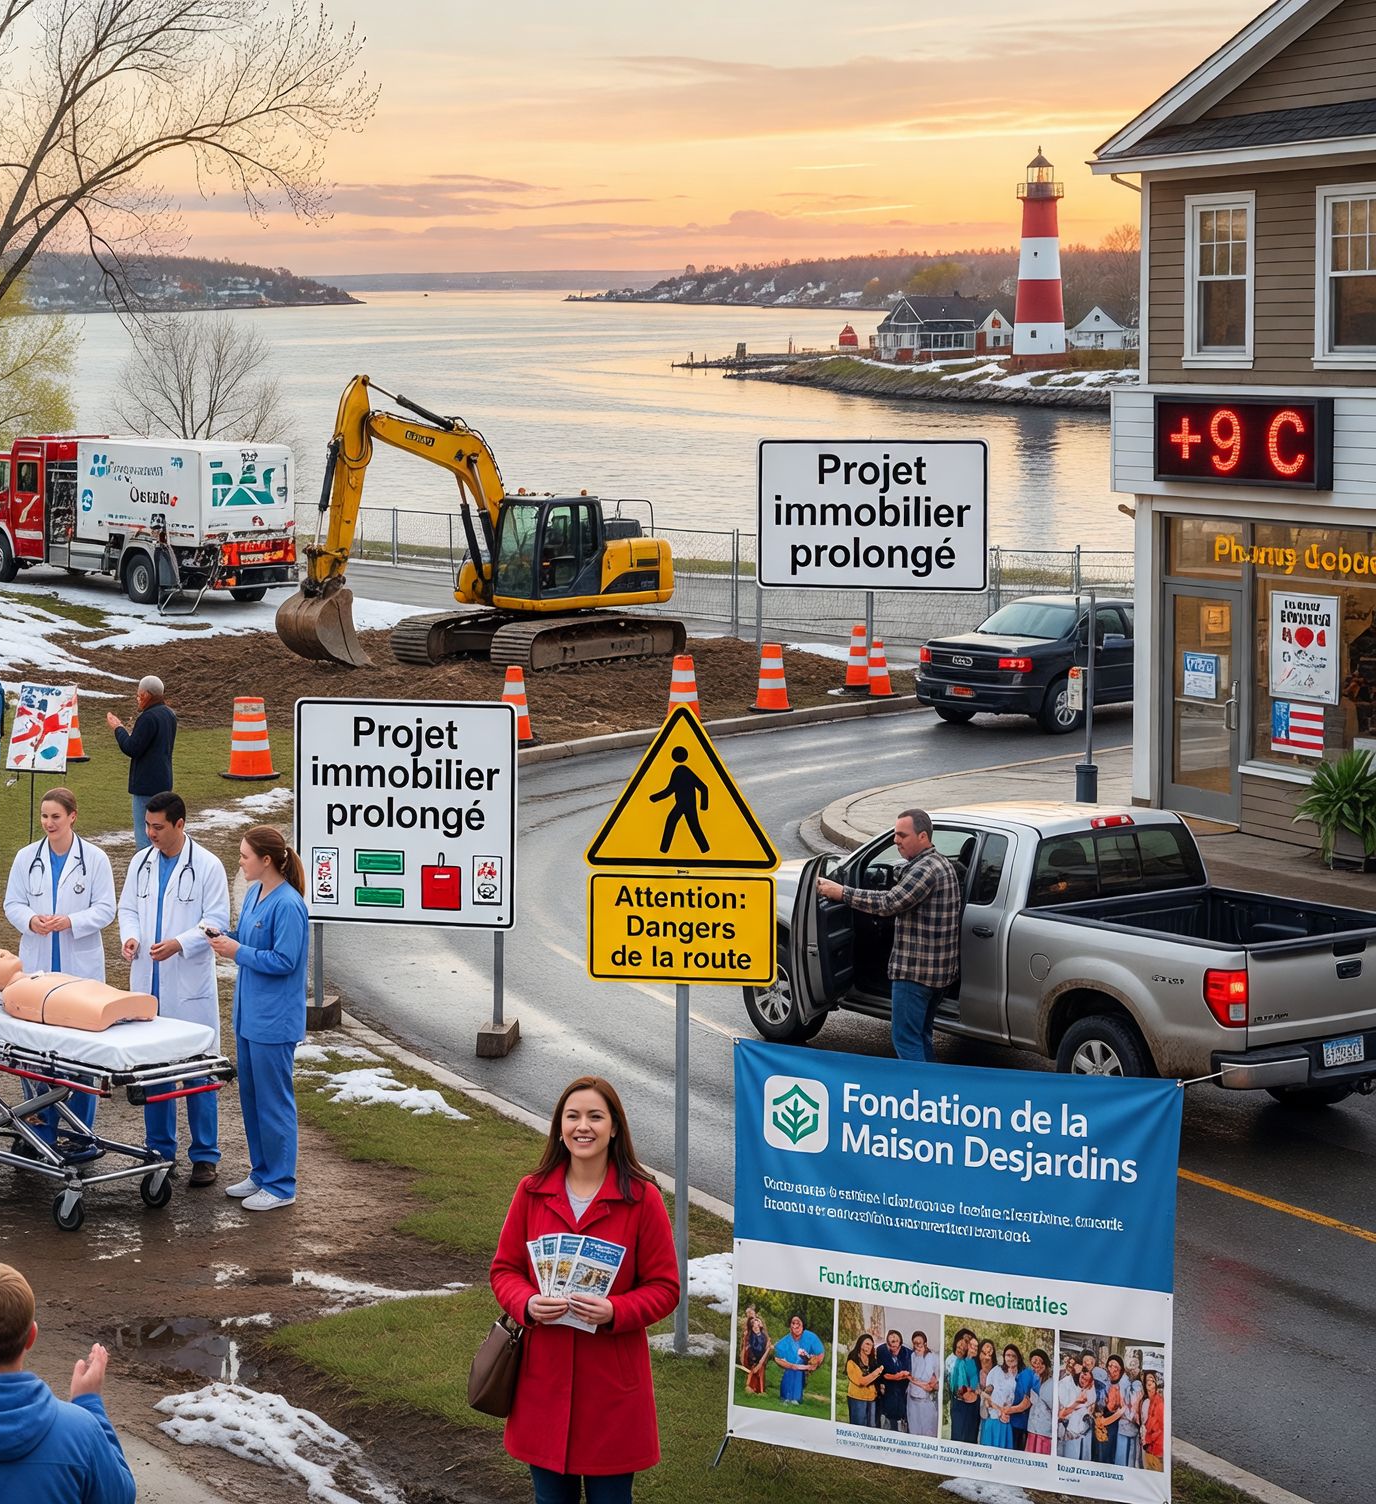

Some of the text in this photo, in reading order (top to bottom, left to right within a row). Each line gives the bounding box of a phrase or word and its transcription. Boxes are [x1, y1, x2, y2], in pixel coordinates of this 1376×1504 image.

[817, 453, 927, 494] Projet
[774, 494, 972, 528] immobilier
[790, 536, 956, 577] prolongé
[353, 716, 458, 758] Projet
[312, 756, 500, 790] immobilier
[326, 797, 485, 838] prolongé
[614, 885, 746, 910] Attention:
[626, 914, 736, 944] Dangers
[611, 944, 752, 970] de la route
[841, 1082, 1088, 1138] Fondation de la
[841, 1121, 1139, 1183] Maison Desjardins
